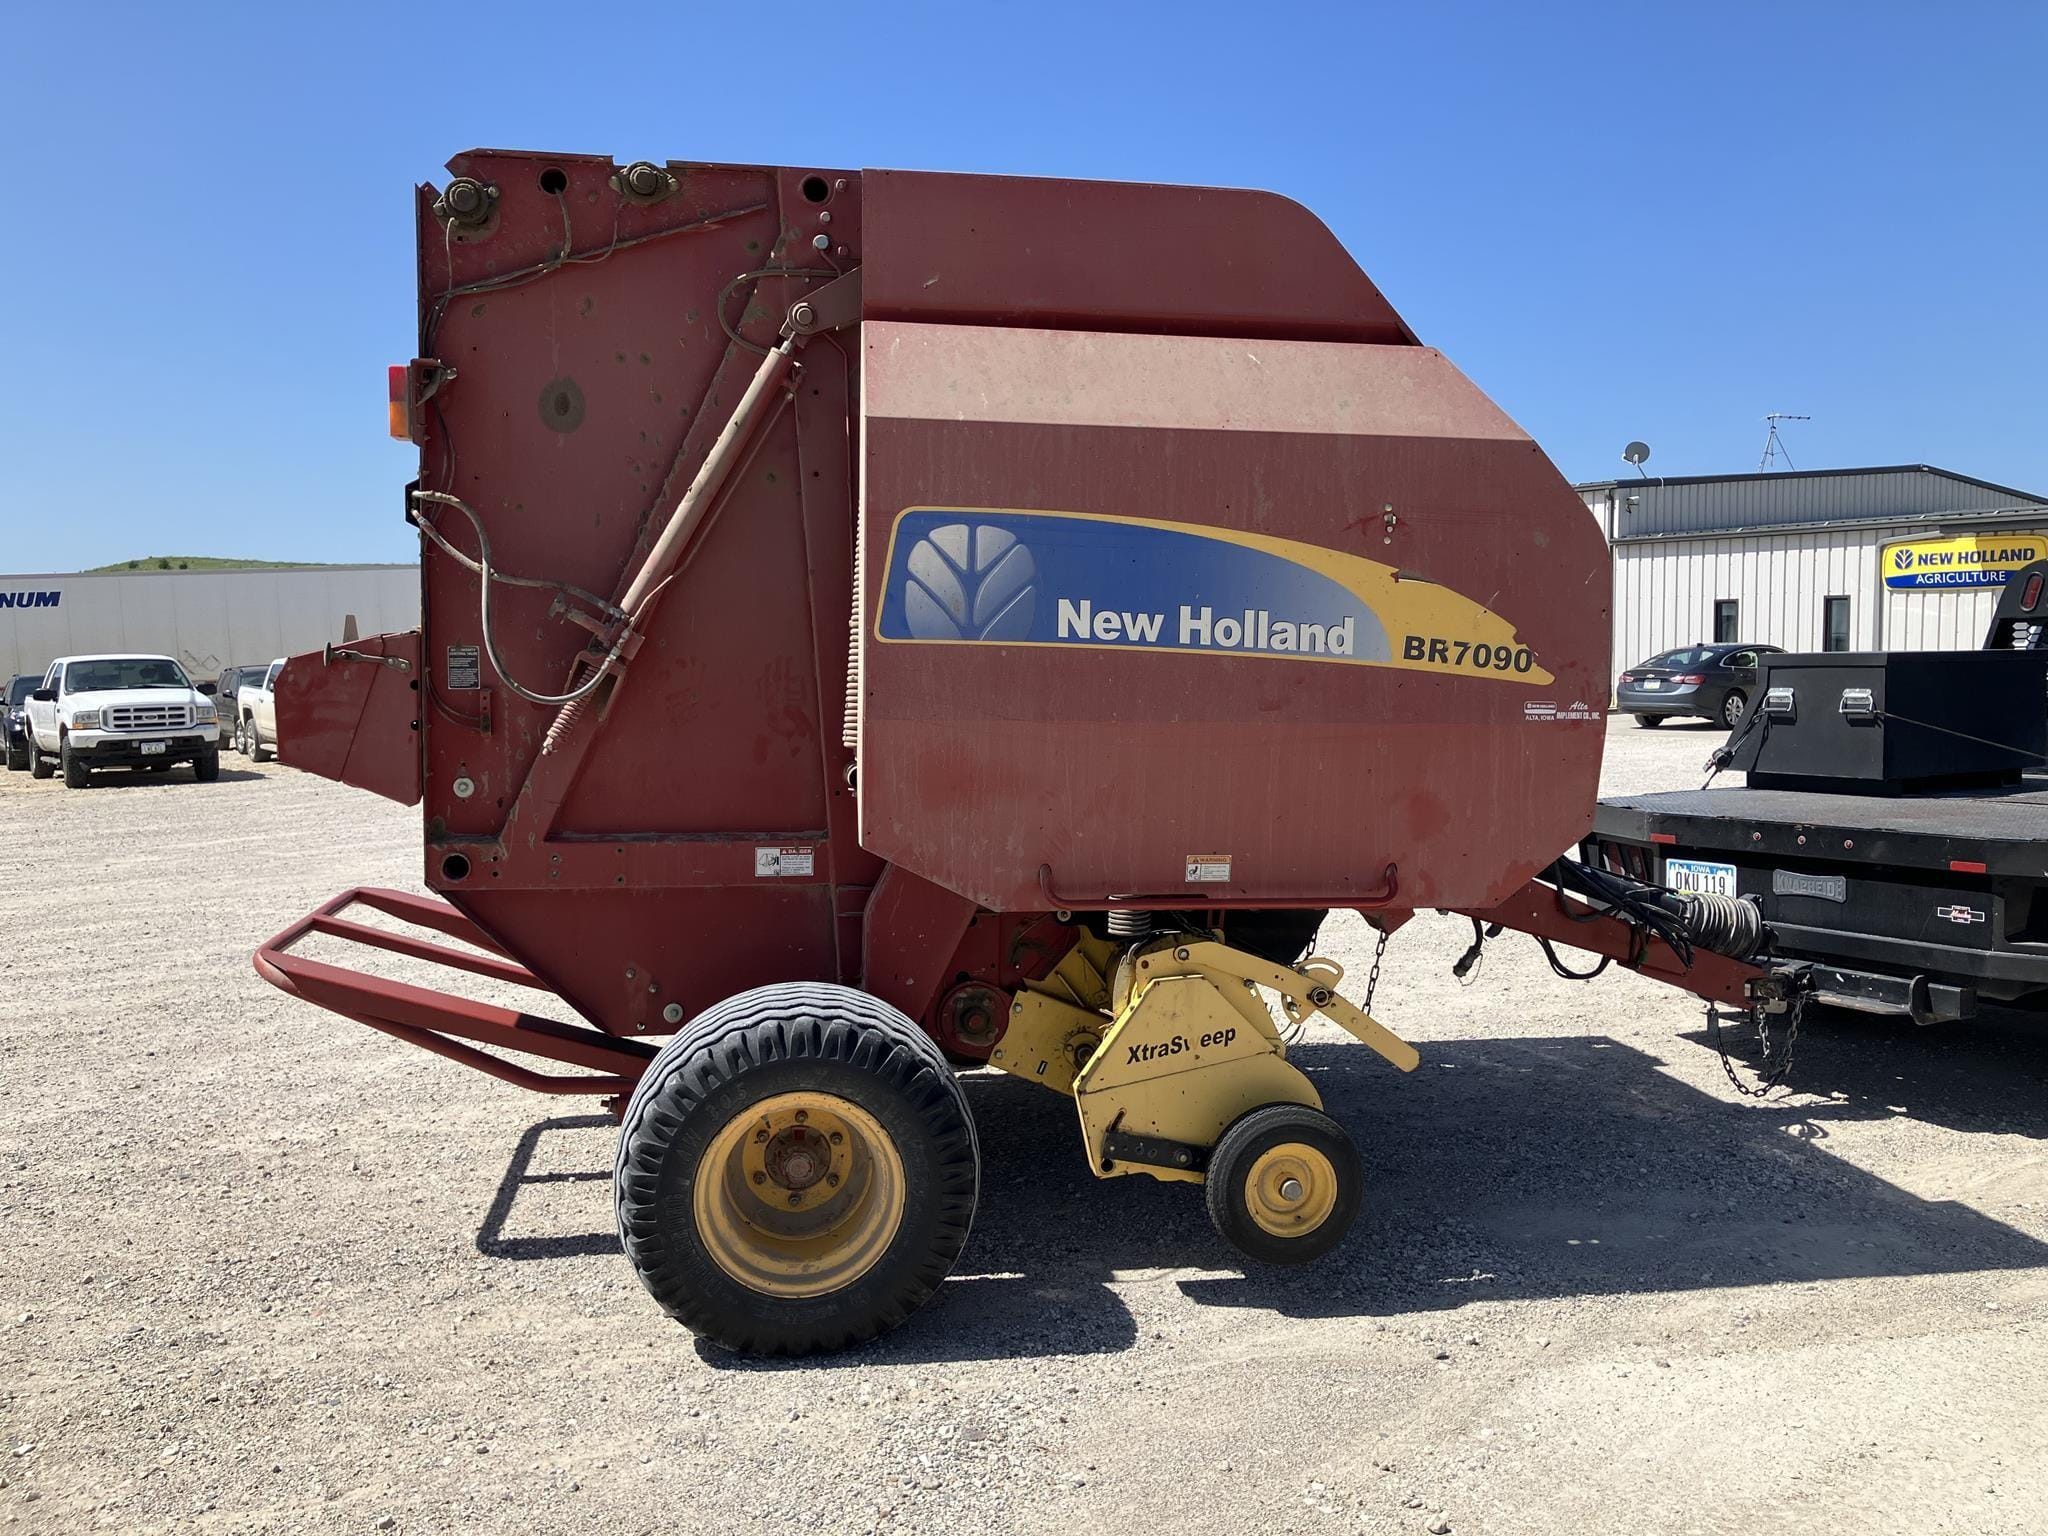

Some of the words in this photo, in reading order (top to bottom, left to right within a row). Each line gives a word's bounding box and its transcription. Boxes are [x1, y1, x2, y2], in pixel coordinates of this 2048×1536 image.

[1917, 552, 1953, 566] NEW
[1958, 547, 2035, 564] HOLLAND
[1916, 570, 2006, 584] AGRICULTURE
[0, 591, 61, 608] NUM
[1057, 598, 1165, 642] New
[1179, 605, 1355, 655] Holland
[1403, 635, 1534, 673] BR7090
[1569, 701, 1589, 710] Alta
[1556, 711, 1582, 720] IMPLEMENT
[1690, 864, 1711, 873] IOWA
[1675, 871, 1699, 892] OKU
[1704, 875, 1726, 895] 119
[1776, 874, 1843, 900] KNAPHEIDE
